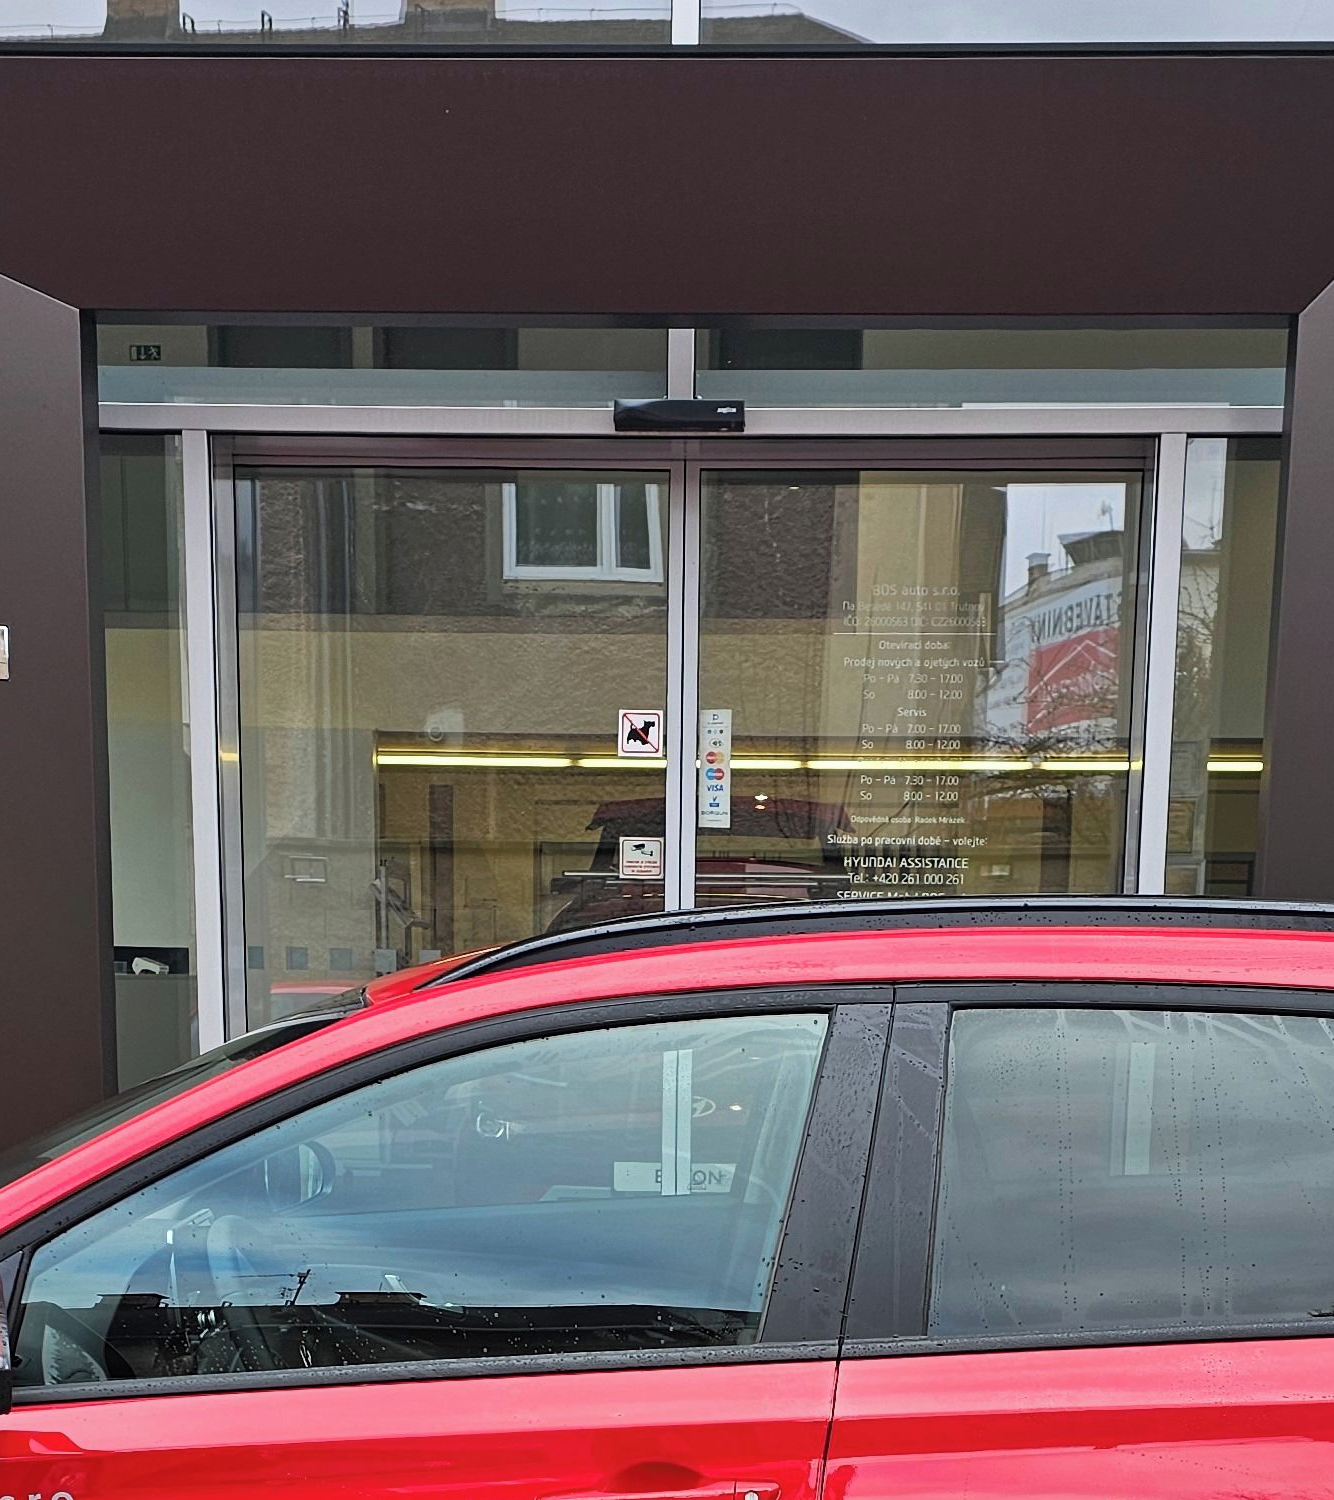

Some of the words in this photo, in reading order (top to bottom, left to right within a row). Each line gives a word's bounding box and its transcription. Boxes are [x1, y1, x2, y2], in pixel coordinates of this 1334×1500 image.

[901, 585, 928, 596] auto
[932, 586, 960, 596] s.r.o.
[844, 656, 875, 669] Prodej
[877, 656, 912, 669] nových
[924, 657, 959, 669] ojetých
[962, 656, 985, 667] vozů
[863, 674, 875, 683] Po
[863, 690, 875, 699] So
[907, 690, 926, 699] 8.00
[939, 690, 962, 699] 12.00
[897, 707, 927, 717] Servis
[862, 724, 874, 733] Po
[862, 740, 873, 749] So
[906, 740, 925, 749] 8.00
[937, 740, 960, 749] 12.00
[860, 775, 872, 785] Po
[707, 784, 723, 792] VISA
[860, 791, 872, 800] So
[903, 791, 923, 800] 8.00
[935, 791, 958, 800] 12.00
[915, 815, 937, 824] Radek
[827, 834, 858, 844] Služba
[861, 837, 872, 846] po
[875, 835, 915, 846] pracovní
[918, 835, 941, 845] době
[952, 836, 988, 847] volejte:
[844, 857, 896, 868] HYUNDAI
[899, 857, 969, 868] ASSISTANCE
[848, 872, 868, 884] Tel.:
[872, 873, 899, 884] +420
[901, 874, 920, 884] 261
[924, 874, 944, 884] 000
[946, 874, 964, 884] 261
